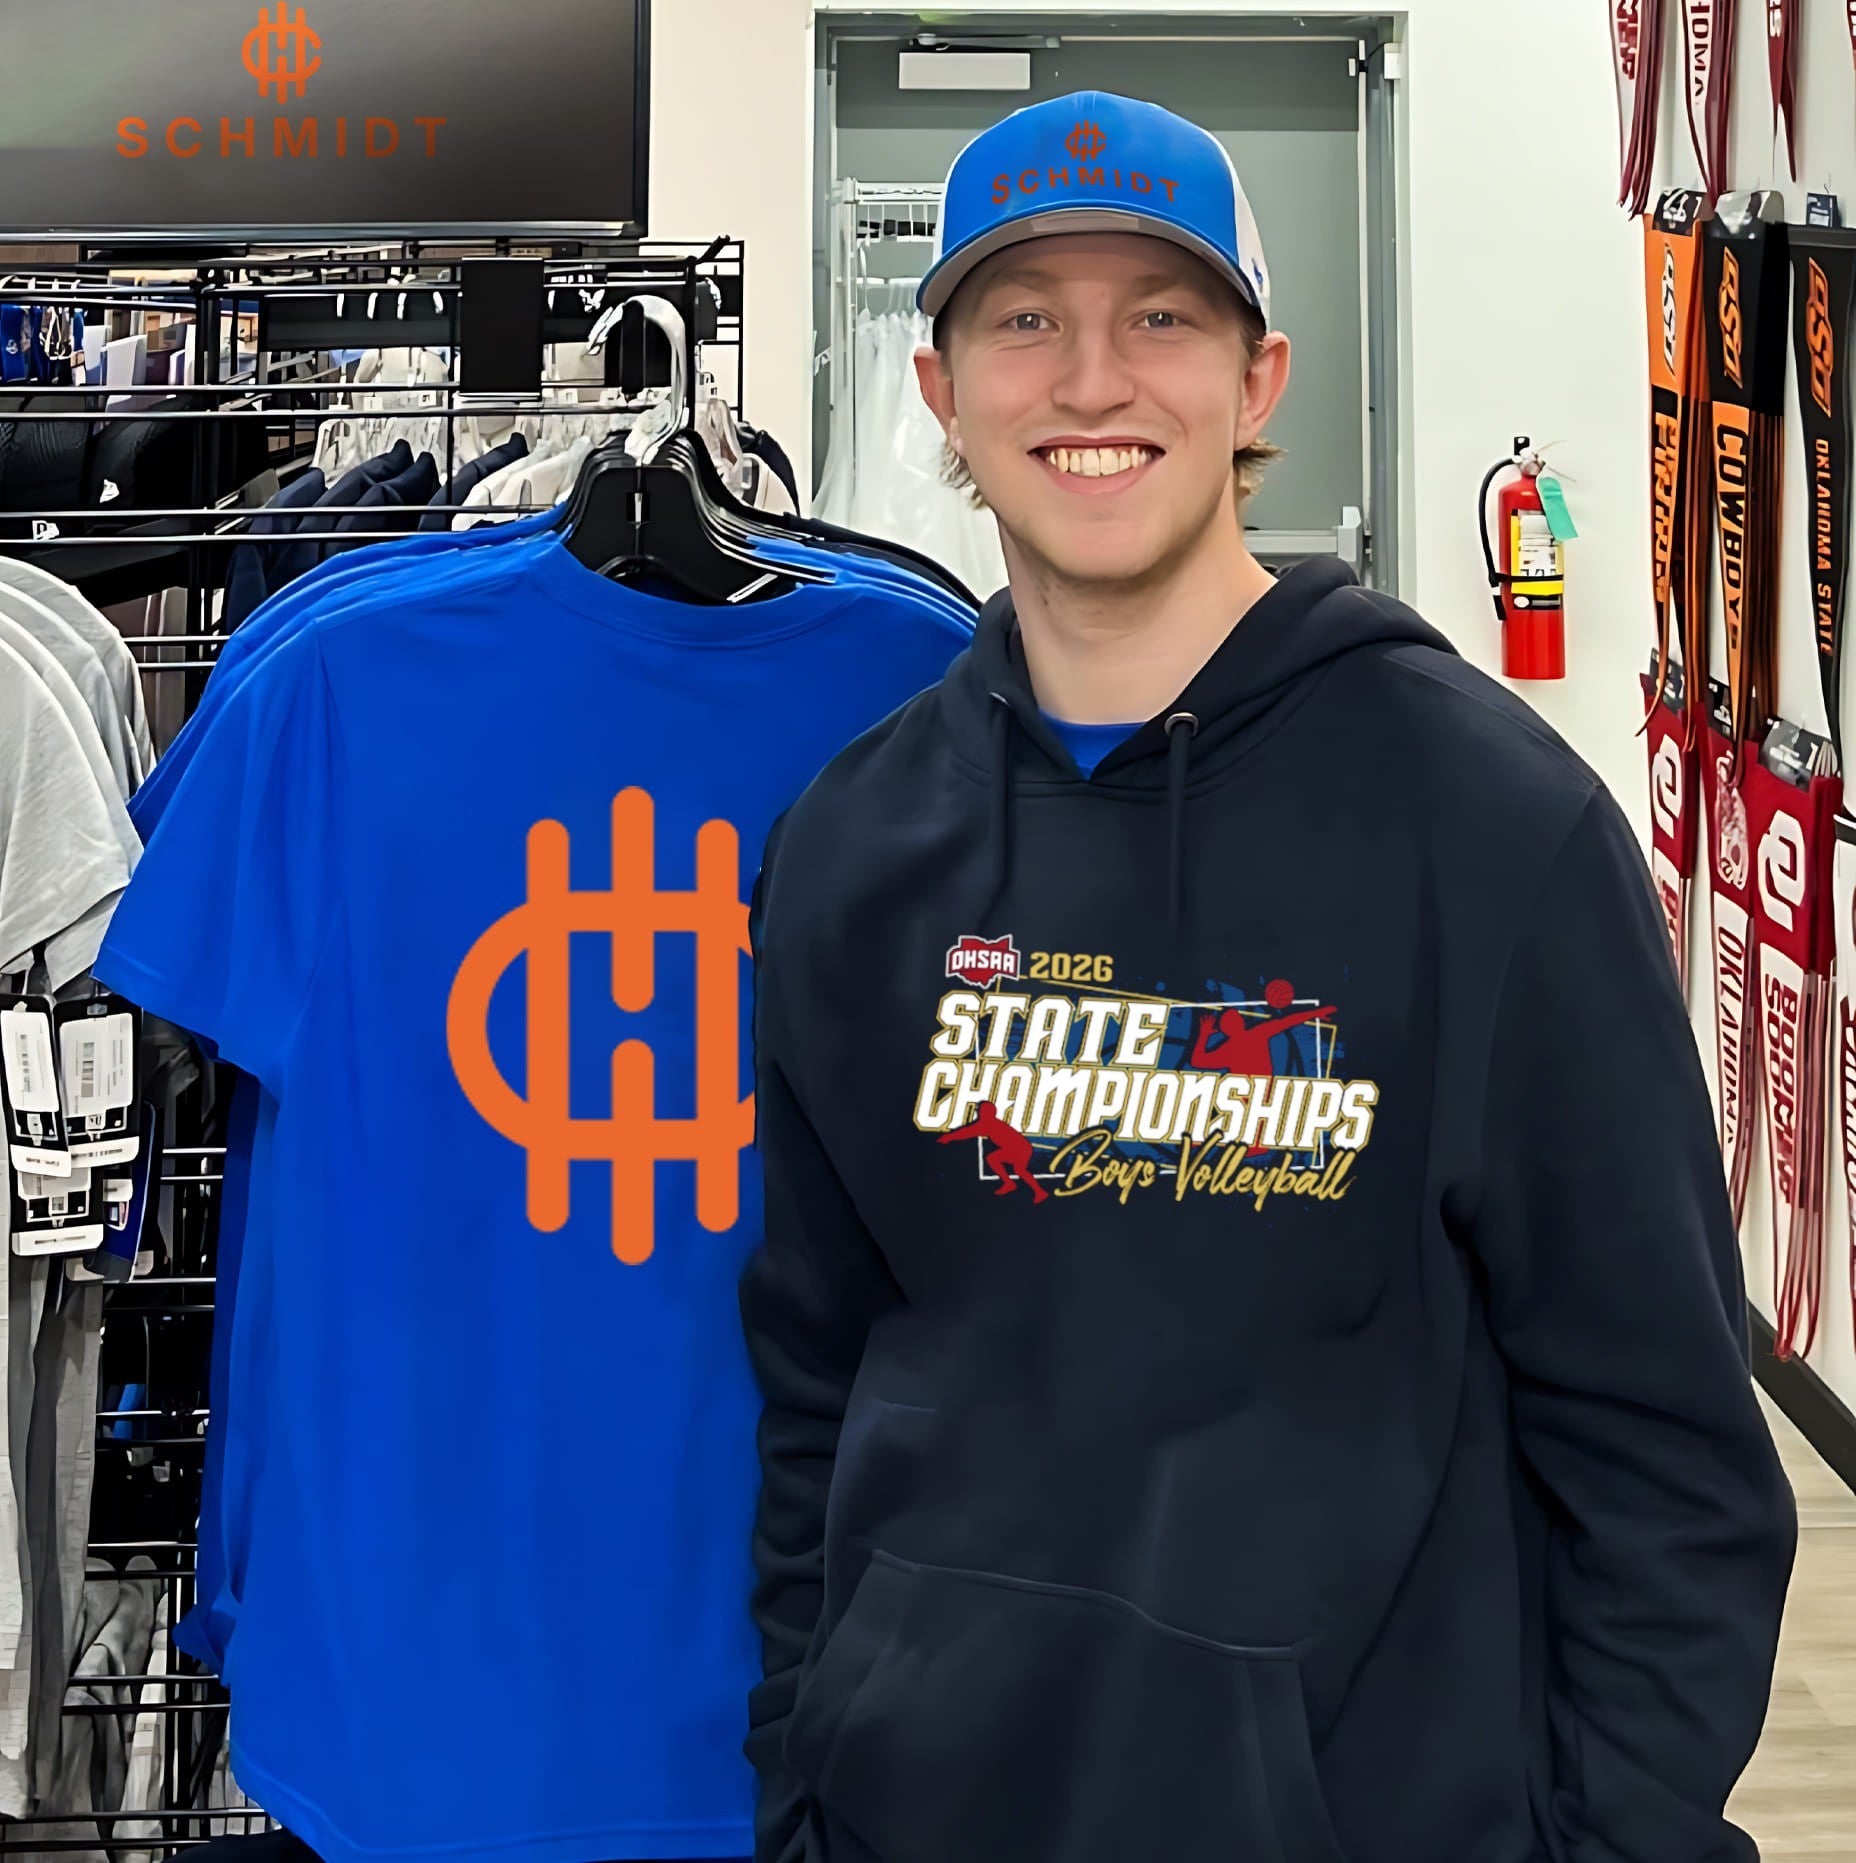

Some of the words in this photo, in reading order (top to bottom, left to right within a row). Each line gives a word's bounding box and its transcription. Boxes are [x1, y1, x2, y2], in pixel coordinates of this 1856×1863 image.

[115, 116, 447, 158] SCHMIDT
[991, 167, 1179, 204] SCHMIDT
[1716, 423, 1747, 650] COWBOY
[1815, 438, 1832, 570] OKLAHOMA
[951, 949, 1016, 974] OHSAA
[1029, 951, 1114, 983] 2026
[930, 990, 1170, 1069] STATE
[913, 1058, 1380, 1152] CHAMPIONSHIPS
[1049, 1129, 1156, 1205] Boys
[1173, 1131, 1357, 1212] Volleyball
